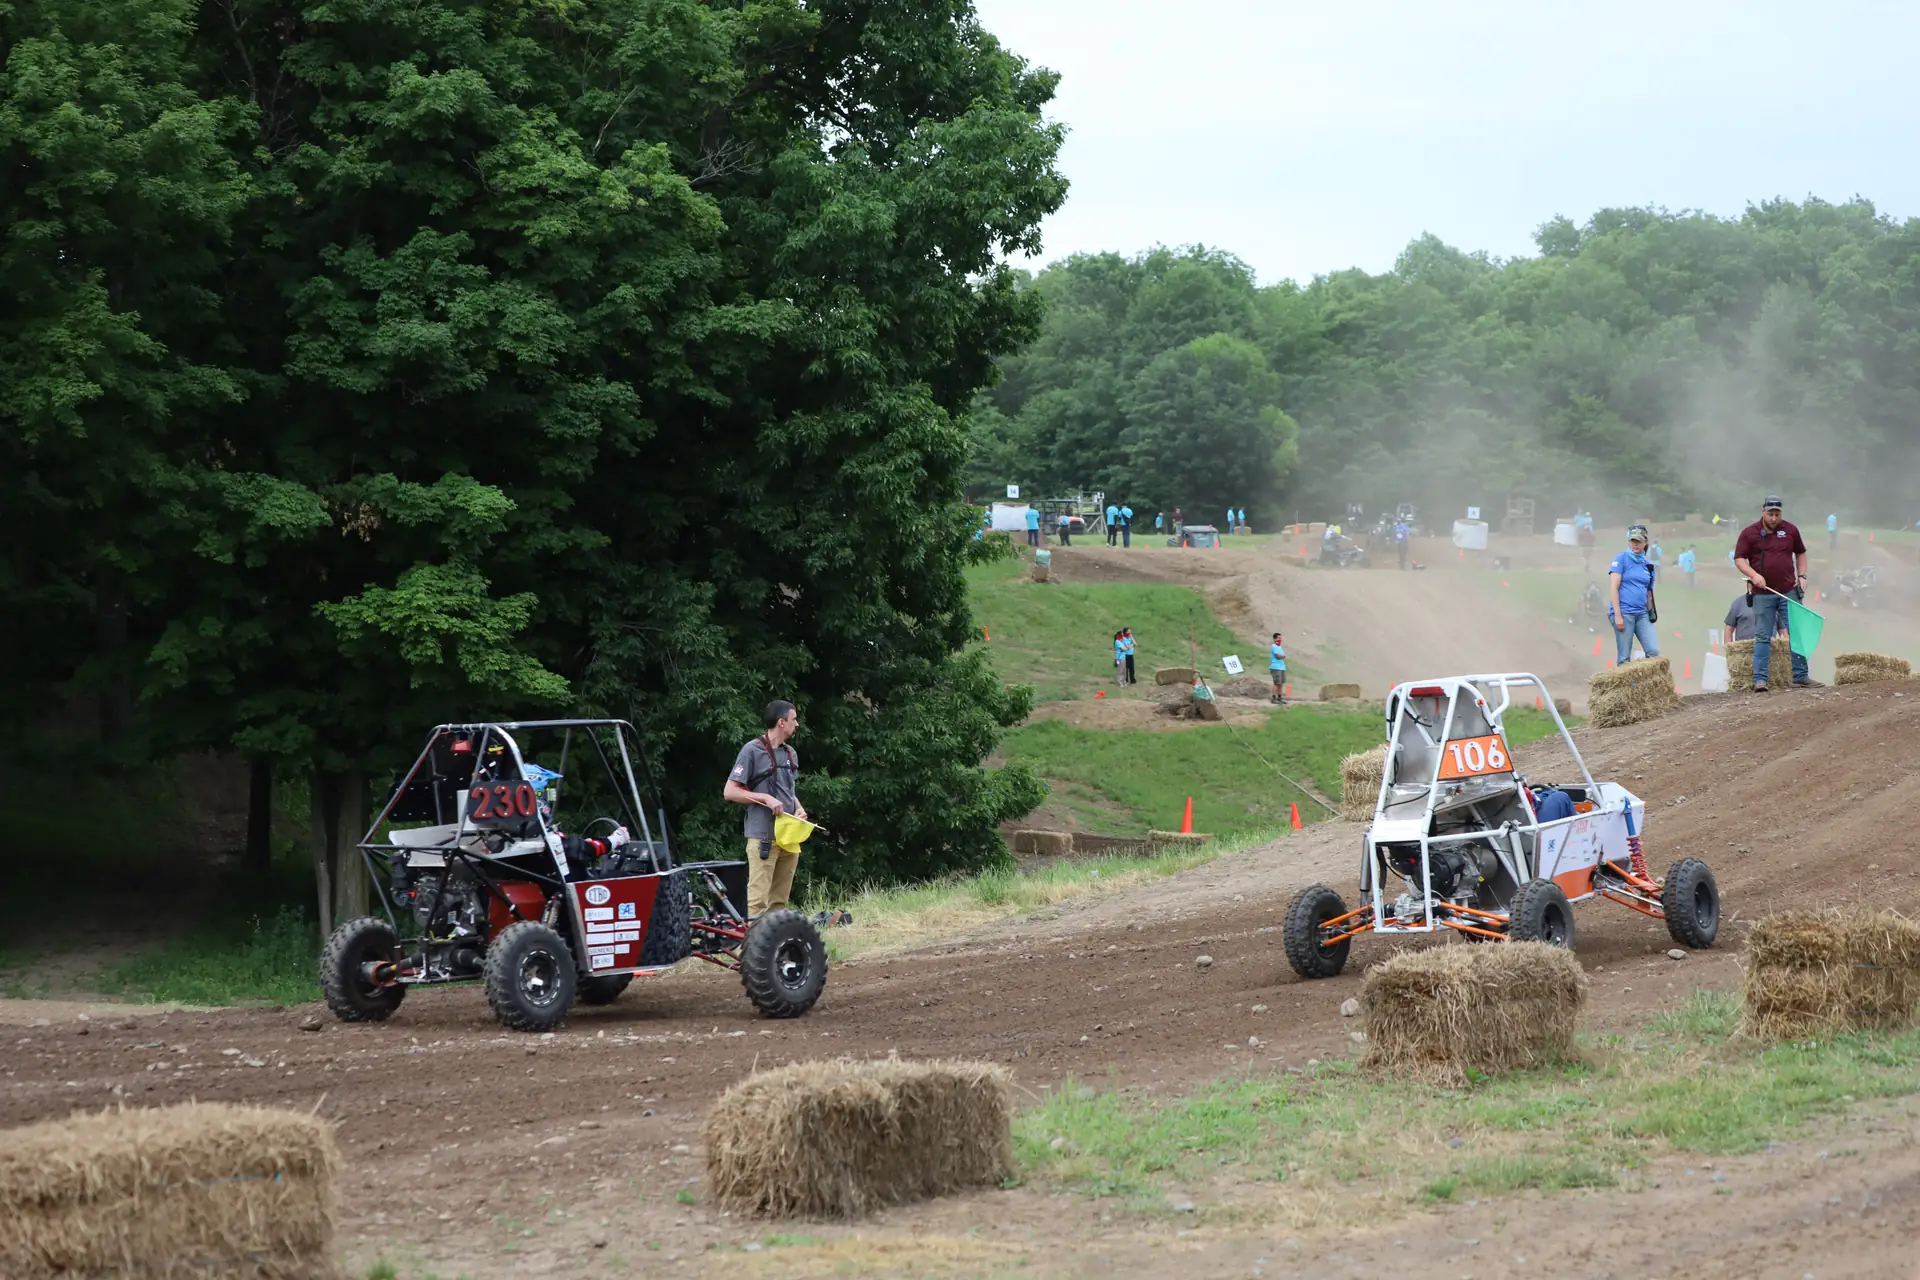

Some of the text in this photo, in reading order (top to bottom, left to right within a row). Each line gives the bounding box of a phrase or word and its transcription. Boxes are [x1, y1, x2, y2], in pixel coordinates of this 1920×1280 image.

[1228, 660, 1237, 669] 18
[1449, 738, 1505, 773] 106
[471, 784, 537, 819] 230
[619, 903, 634, 915] SAE
